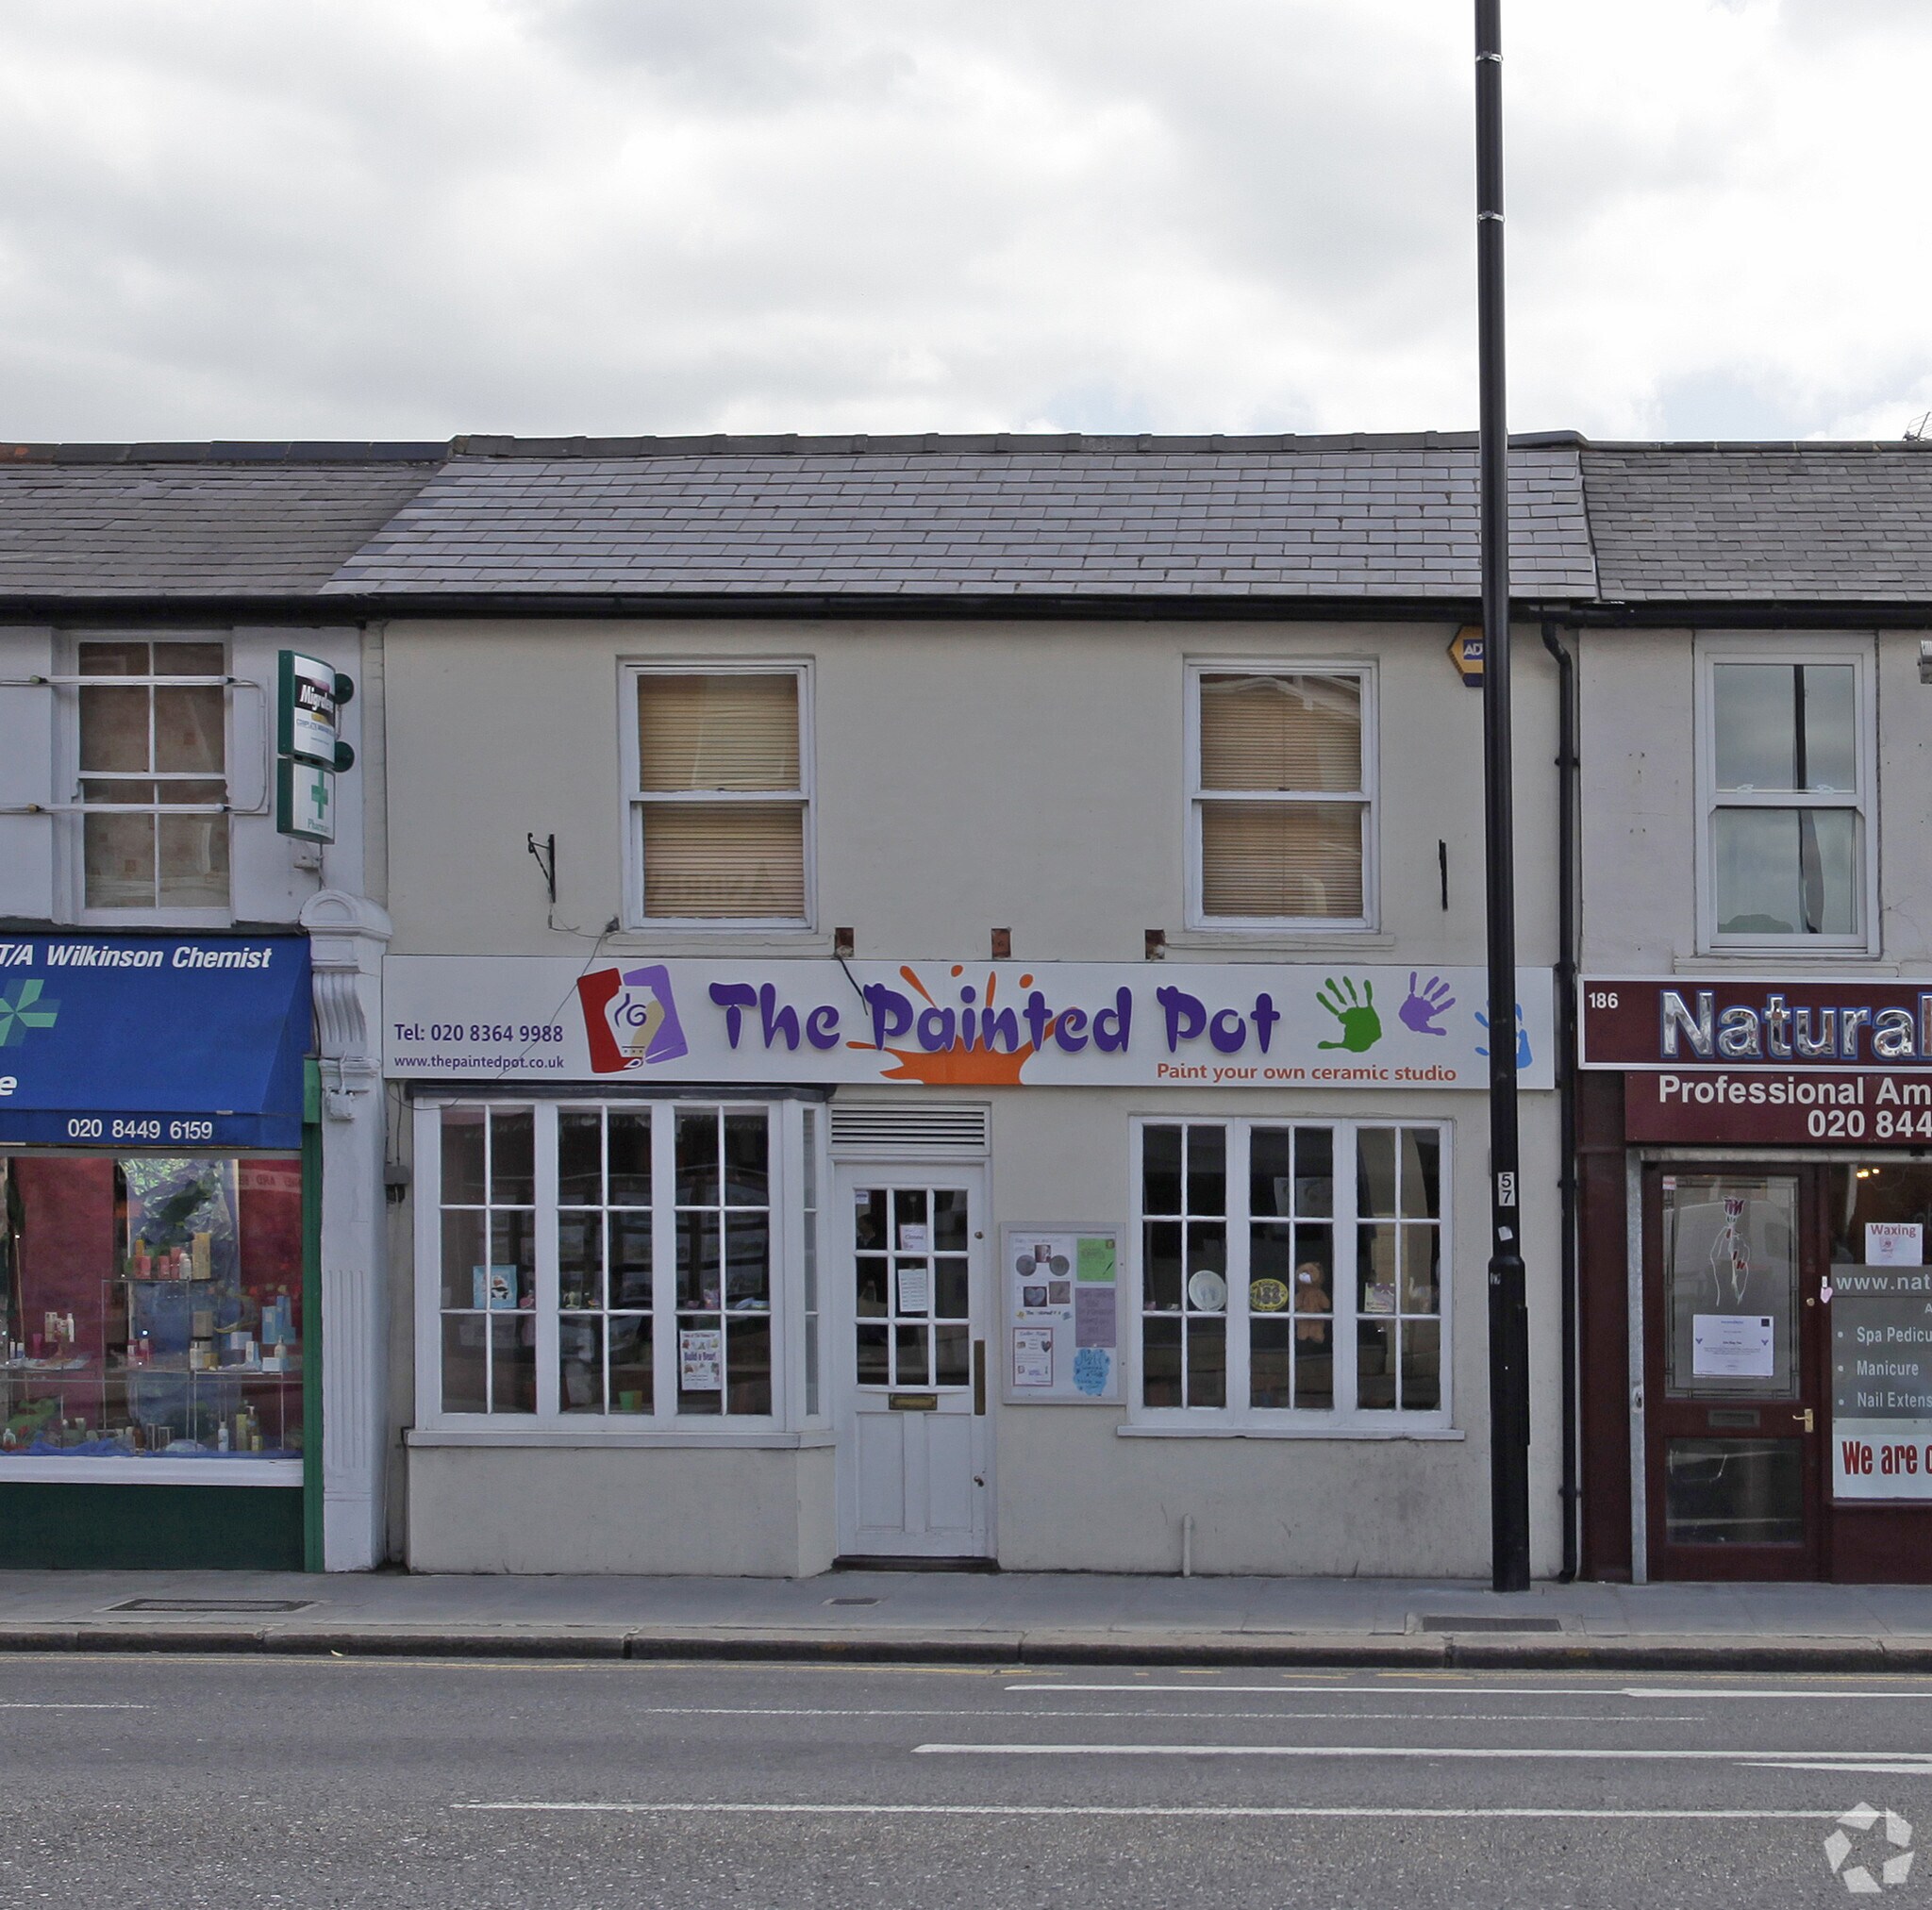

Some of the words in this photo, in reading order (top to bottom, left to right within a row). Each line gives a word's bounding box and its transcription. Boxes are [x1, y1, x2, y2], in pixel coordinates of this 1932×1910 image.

[1463, 643, 1484, 656] AD
[0, 944, 34, 967] T/A
[47, 945, 163, 968] Wilkinson
[172, 946, 273, 969] Chemist
[1588, 992, 1619, 1009] 186
[708, 982, 841, 1051] The
[863, 983, 1132, 1054] Painted
[1156, 985, 1281, 1055] Pot
[1660, 990, 1932, 1061] Natural
[393, 1023, 425, 1041] Tel:
[430, 1024, 463, 1041] 020
[470, 1024, 514, 1042] 8364
[520, 1025, 564, 1043] 9988
[393, 1055, 565, 1071] www.thepaintedpot.co.uk
[1157, 1062, 1208, 1080] Paint
[1212, 1066, 1257, 1083] your
[1263, 1067, 1306, 1081] own
[1311, 1064, 1390, 1081] ceramic
[1394, 1064, 1457, 1082] studio
[1659, 1075, 1865, 1105] Professional
[1874, 1077, 1932, 1105] Am
[67, 1119, 103, 1138] 020
[112, 1120, 161, 1139] 8449
[170, 1121, 213, 1139] 6159
[1807, 1110, 1866, 1138] 020
[1875, 1110, 1932, 1138] 844
[1870, 1224, 1917, 1238] Waxing
[1836, 1273, 1931, 1290] www.nat
[1857, 1326, 1883, 1346] Spa
[1887, 1326, 1932, 1342] Pedicu
[1857, 1359, 1919, 1376] Manicure
[1857, 1391, 1883, 1407] Nail
[1888, 1391, 1932, 1408] Extens
[1841, 1440, 1874, 1475] We
[1881, 1444, 1918, 1475] are
